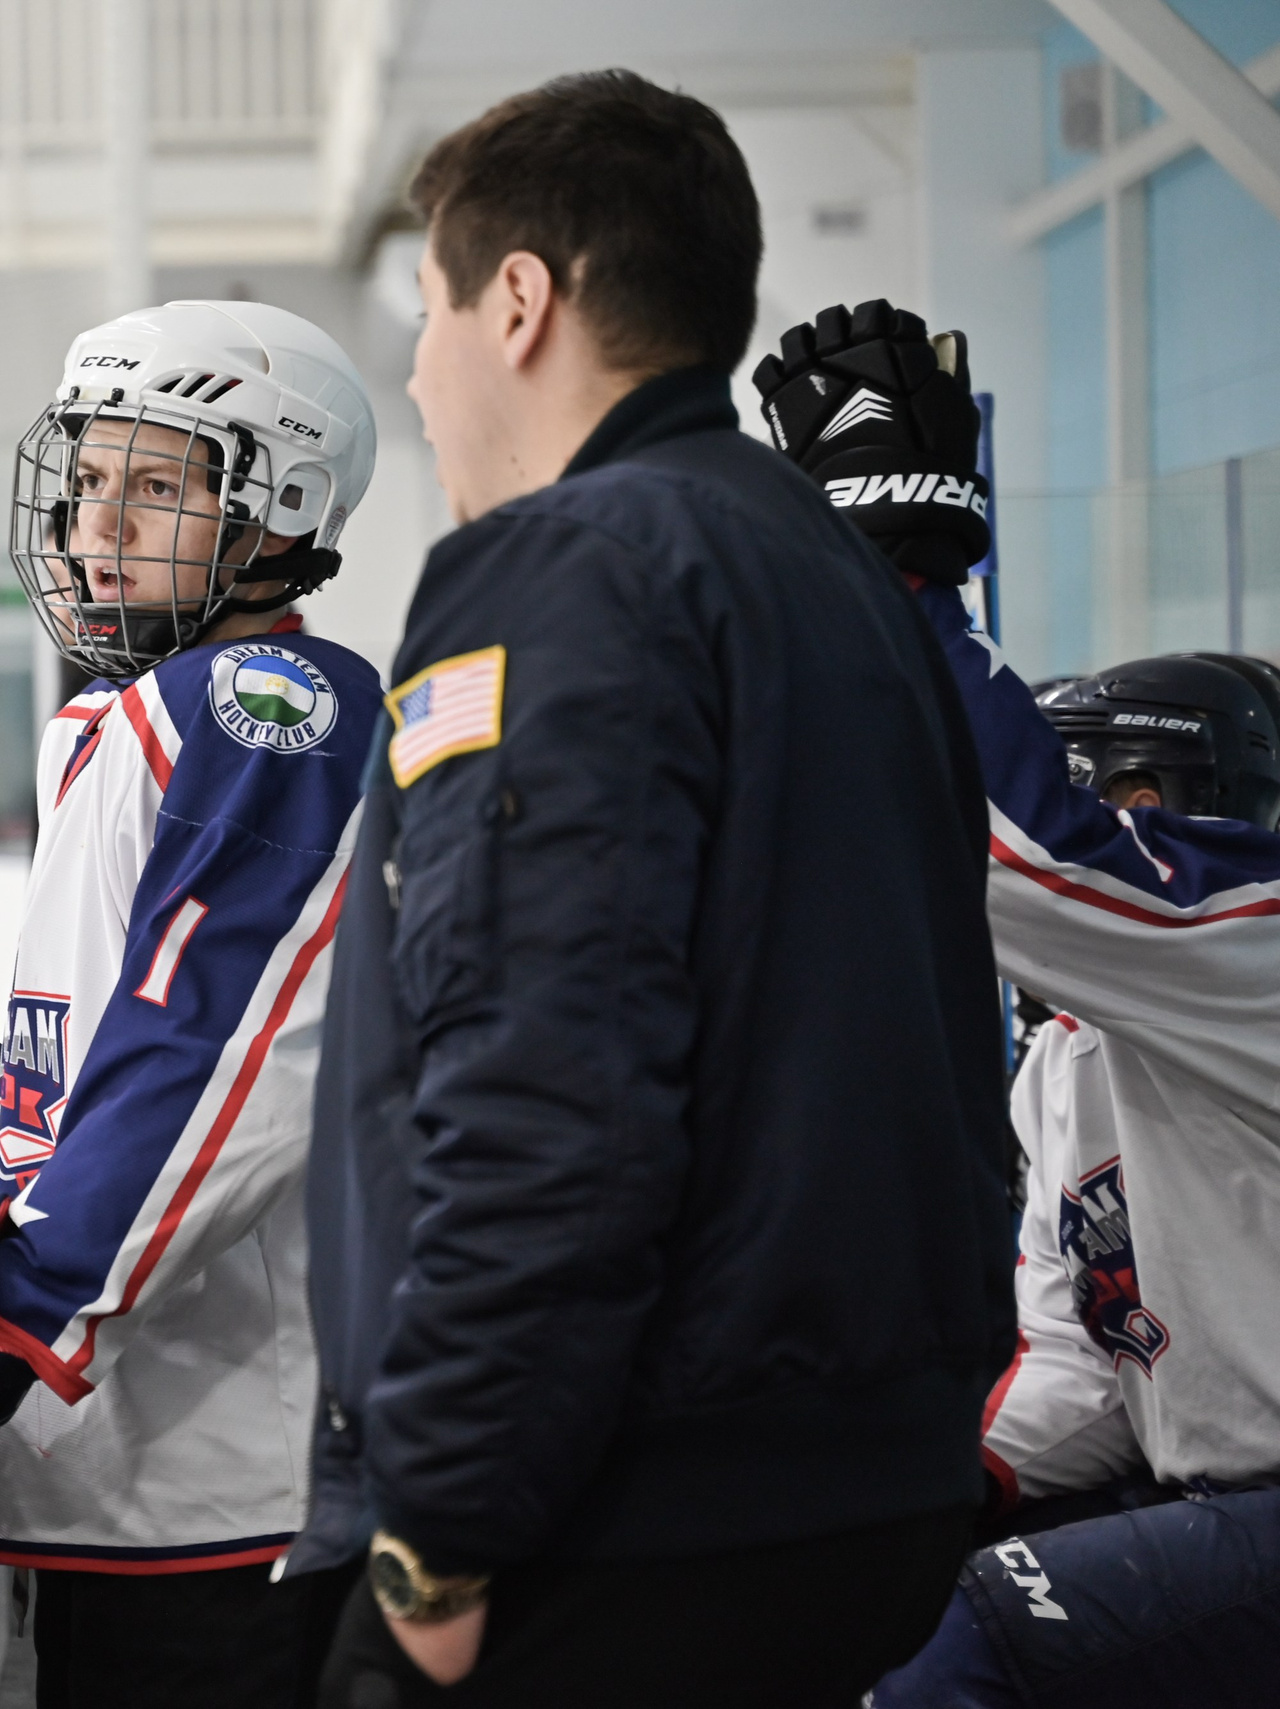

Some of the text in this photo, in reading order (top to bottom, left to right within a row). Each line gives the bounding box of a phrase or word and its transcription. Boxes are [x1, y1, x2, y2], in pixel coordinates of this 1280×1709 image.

[80, 356, 141, 370] CCM
[278, 416, 322, 439] CCM
[824, 473, 988, 520] PRIME
[225, 646, 330, 694] DREAM TEAM
[218, 699, 275, 741] HOCKY
[1113, 713, 1201, 733] BAUER
[0, 1006, 61, 1085] AM
[994, 1536, 1069, 1621] CM
